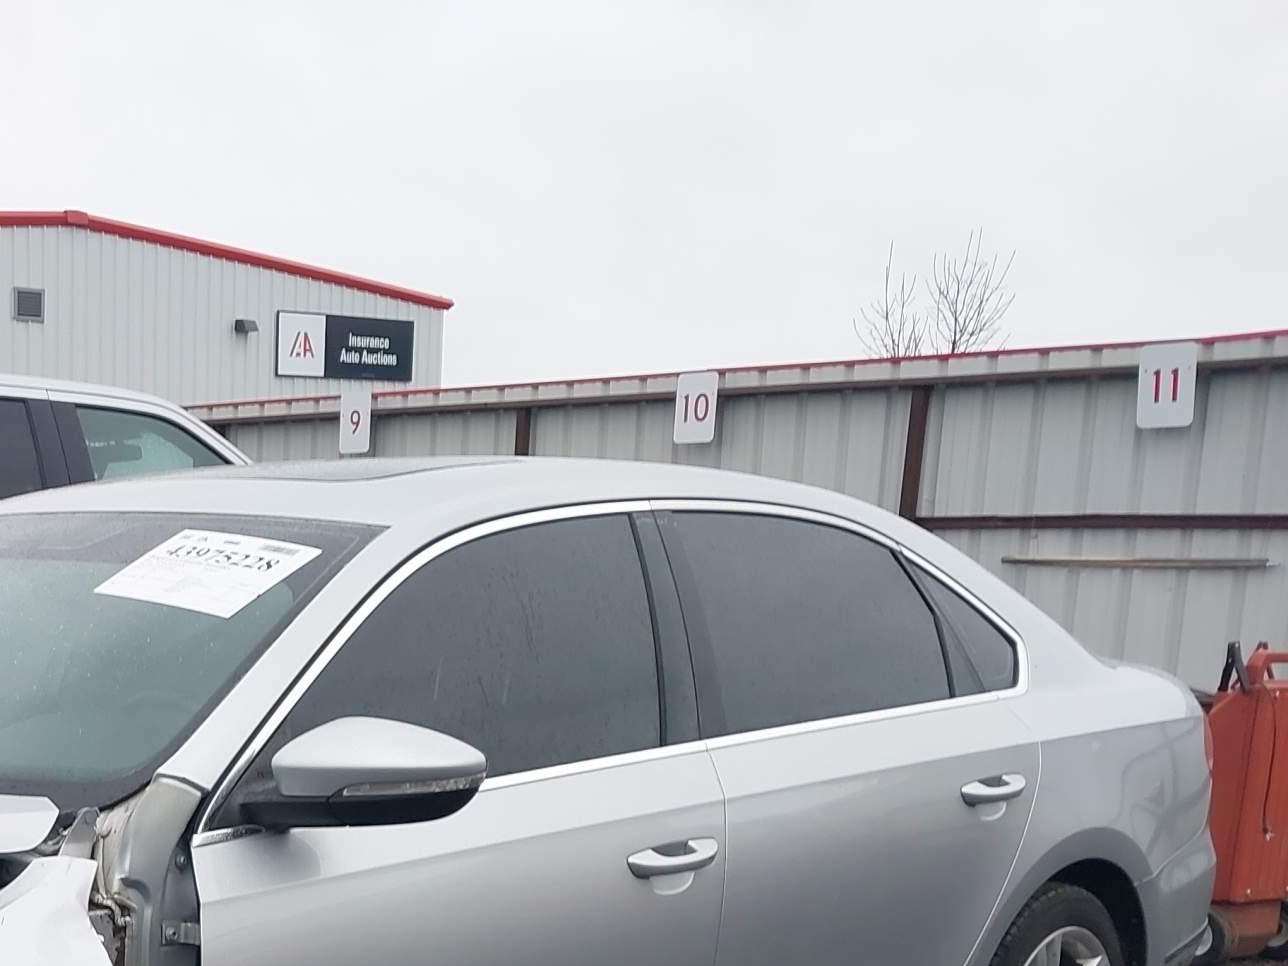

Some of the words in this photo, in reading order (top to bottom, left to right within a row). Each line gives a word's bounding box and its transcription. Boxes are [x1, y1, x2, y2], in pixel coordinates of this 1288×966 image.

[348, 332, 390, 349] Insurance
[340, 347, 360, 364] Auto
[361, 350, 397, 366] Auctions
[1153, 367, 1179, 404] 11
[683, 393, 709, 423] 10
[350, 410, 361, 435] 9
